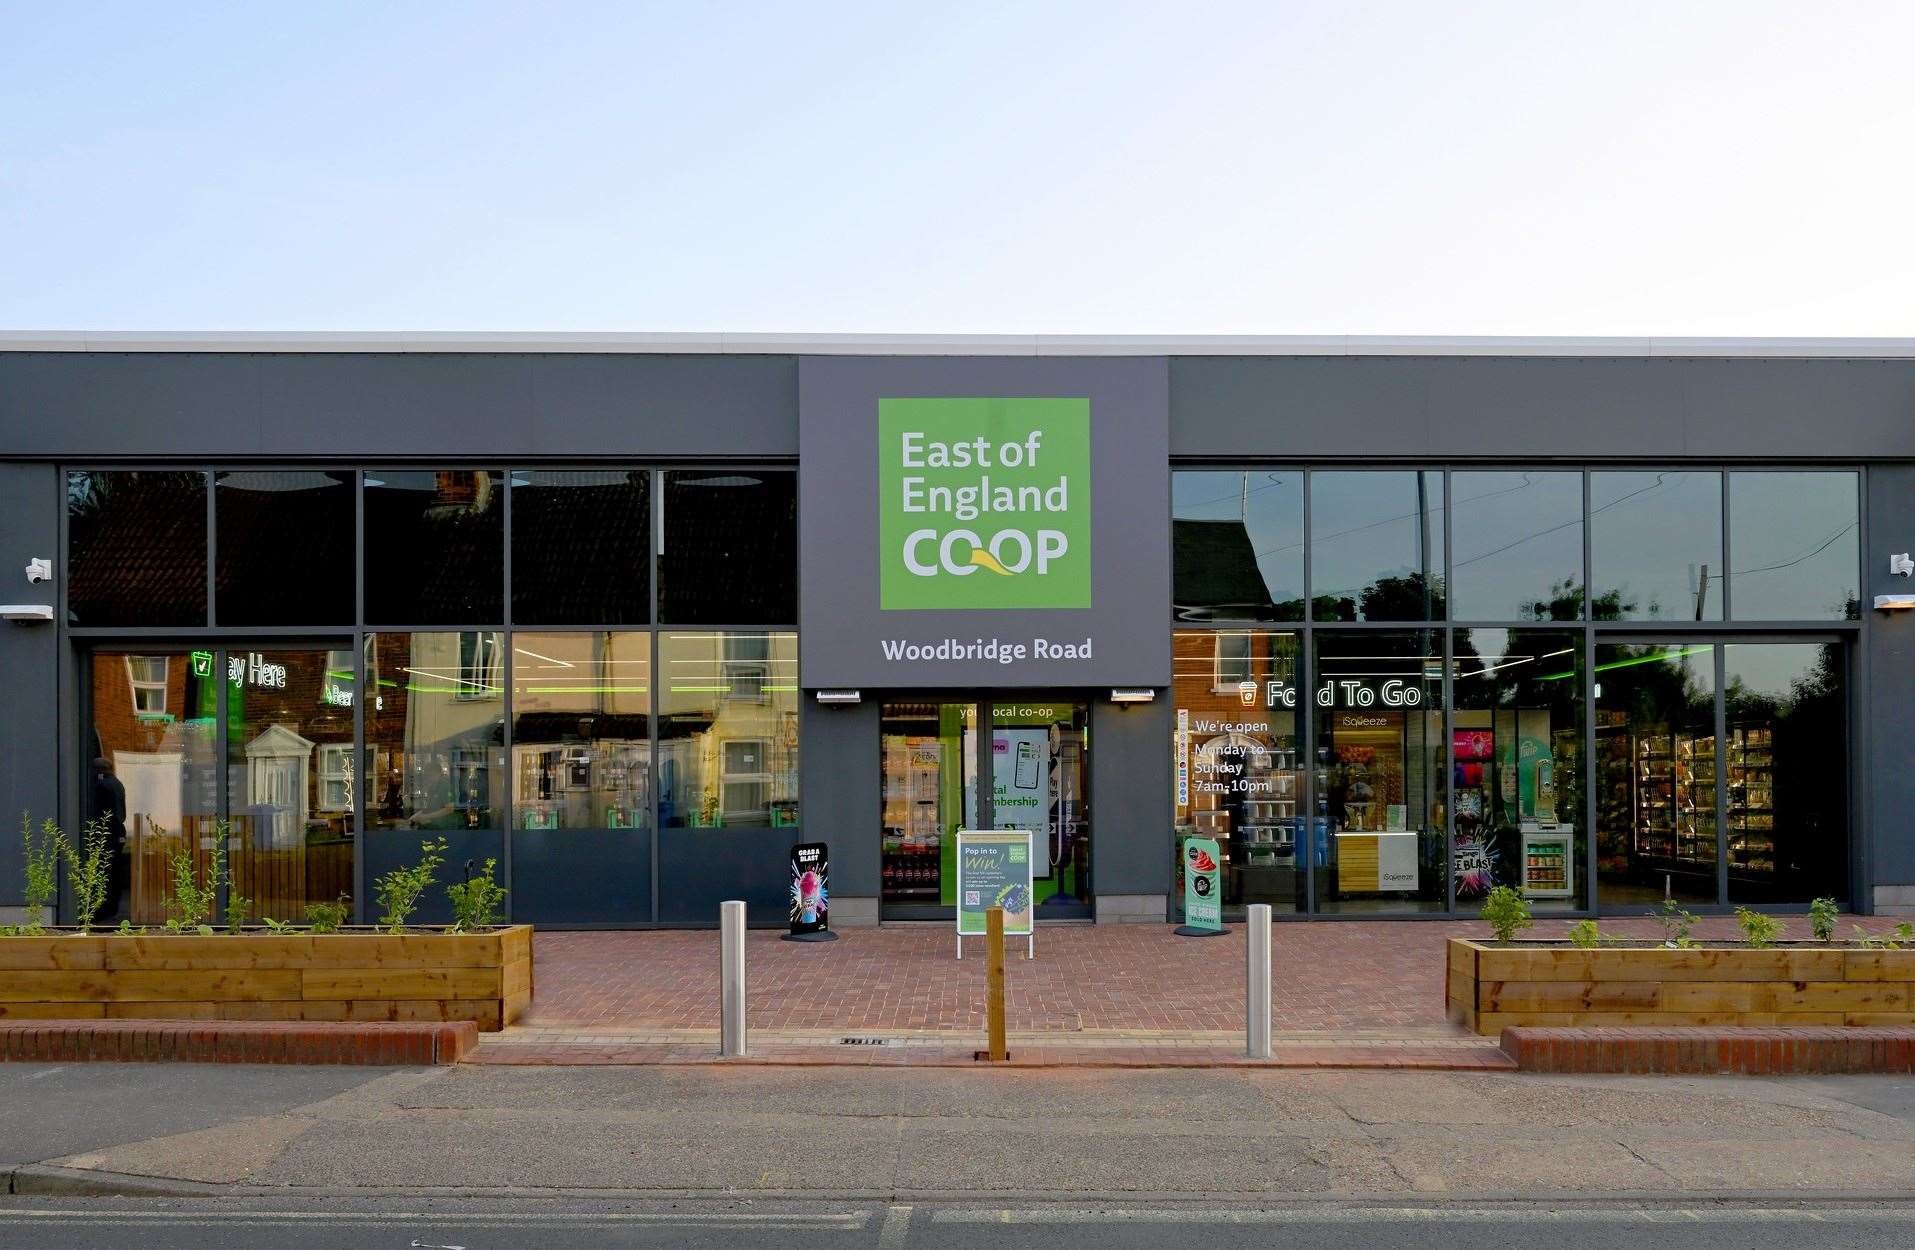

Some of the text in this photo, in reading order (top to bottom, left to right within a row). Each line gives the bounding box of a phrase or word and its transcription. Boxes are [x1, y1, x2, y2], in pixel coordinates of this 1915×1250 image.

[902, 431, 1042, 467] East of
[903, 476, 1068, 520] England
[903, 529, 1068, 576] COOP
[881, 638, 1092, 664] Woodbridge Road
[228, 653, 286, 688] ay Here
[1267, 680, 1421, 707] Fod To Go
[993, 706, 1016, 717] ocal
[1020, 707, 1053, 719] co-op
[1195, 720, 1267, 735] We're open
[1195, 744, 1264, 758] Monday to
[1194, 762, 1243, 776] Sunday
[1195, 780, 1269, 794] 7am-10pm
[1463, 857, 1493, 870] BLAST
